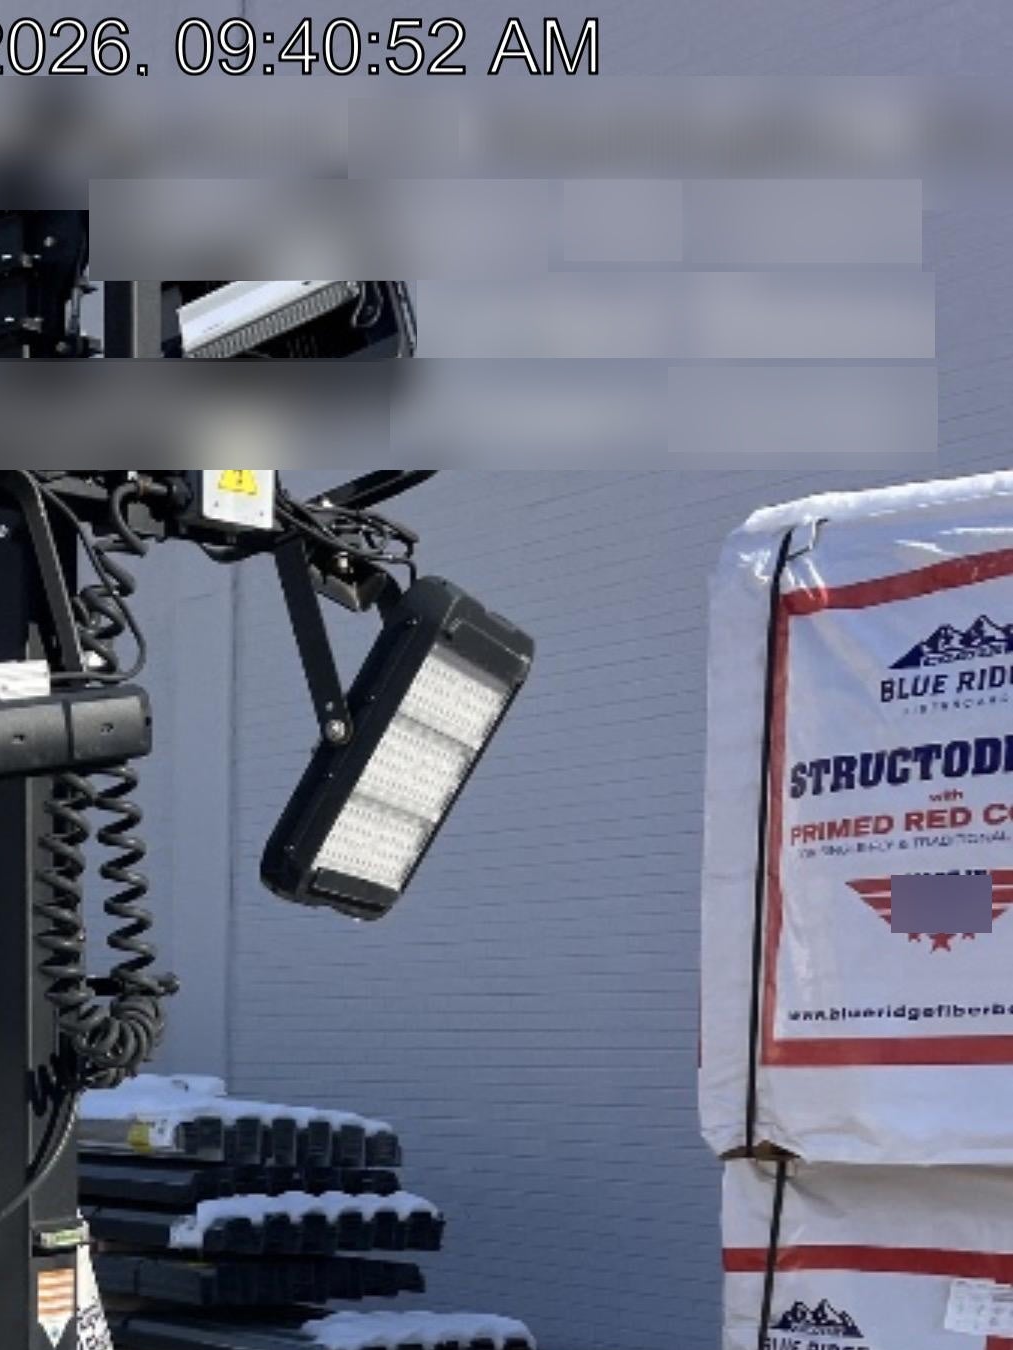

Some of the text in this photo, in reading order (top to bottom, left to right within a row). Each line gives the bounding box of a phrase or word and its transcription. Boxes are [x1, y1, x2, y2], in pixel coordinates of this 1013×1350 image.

[881, 665, 1013, 702] BLUE RID
[791, 803, 1013, 846] PRIMED RED C
